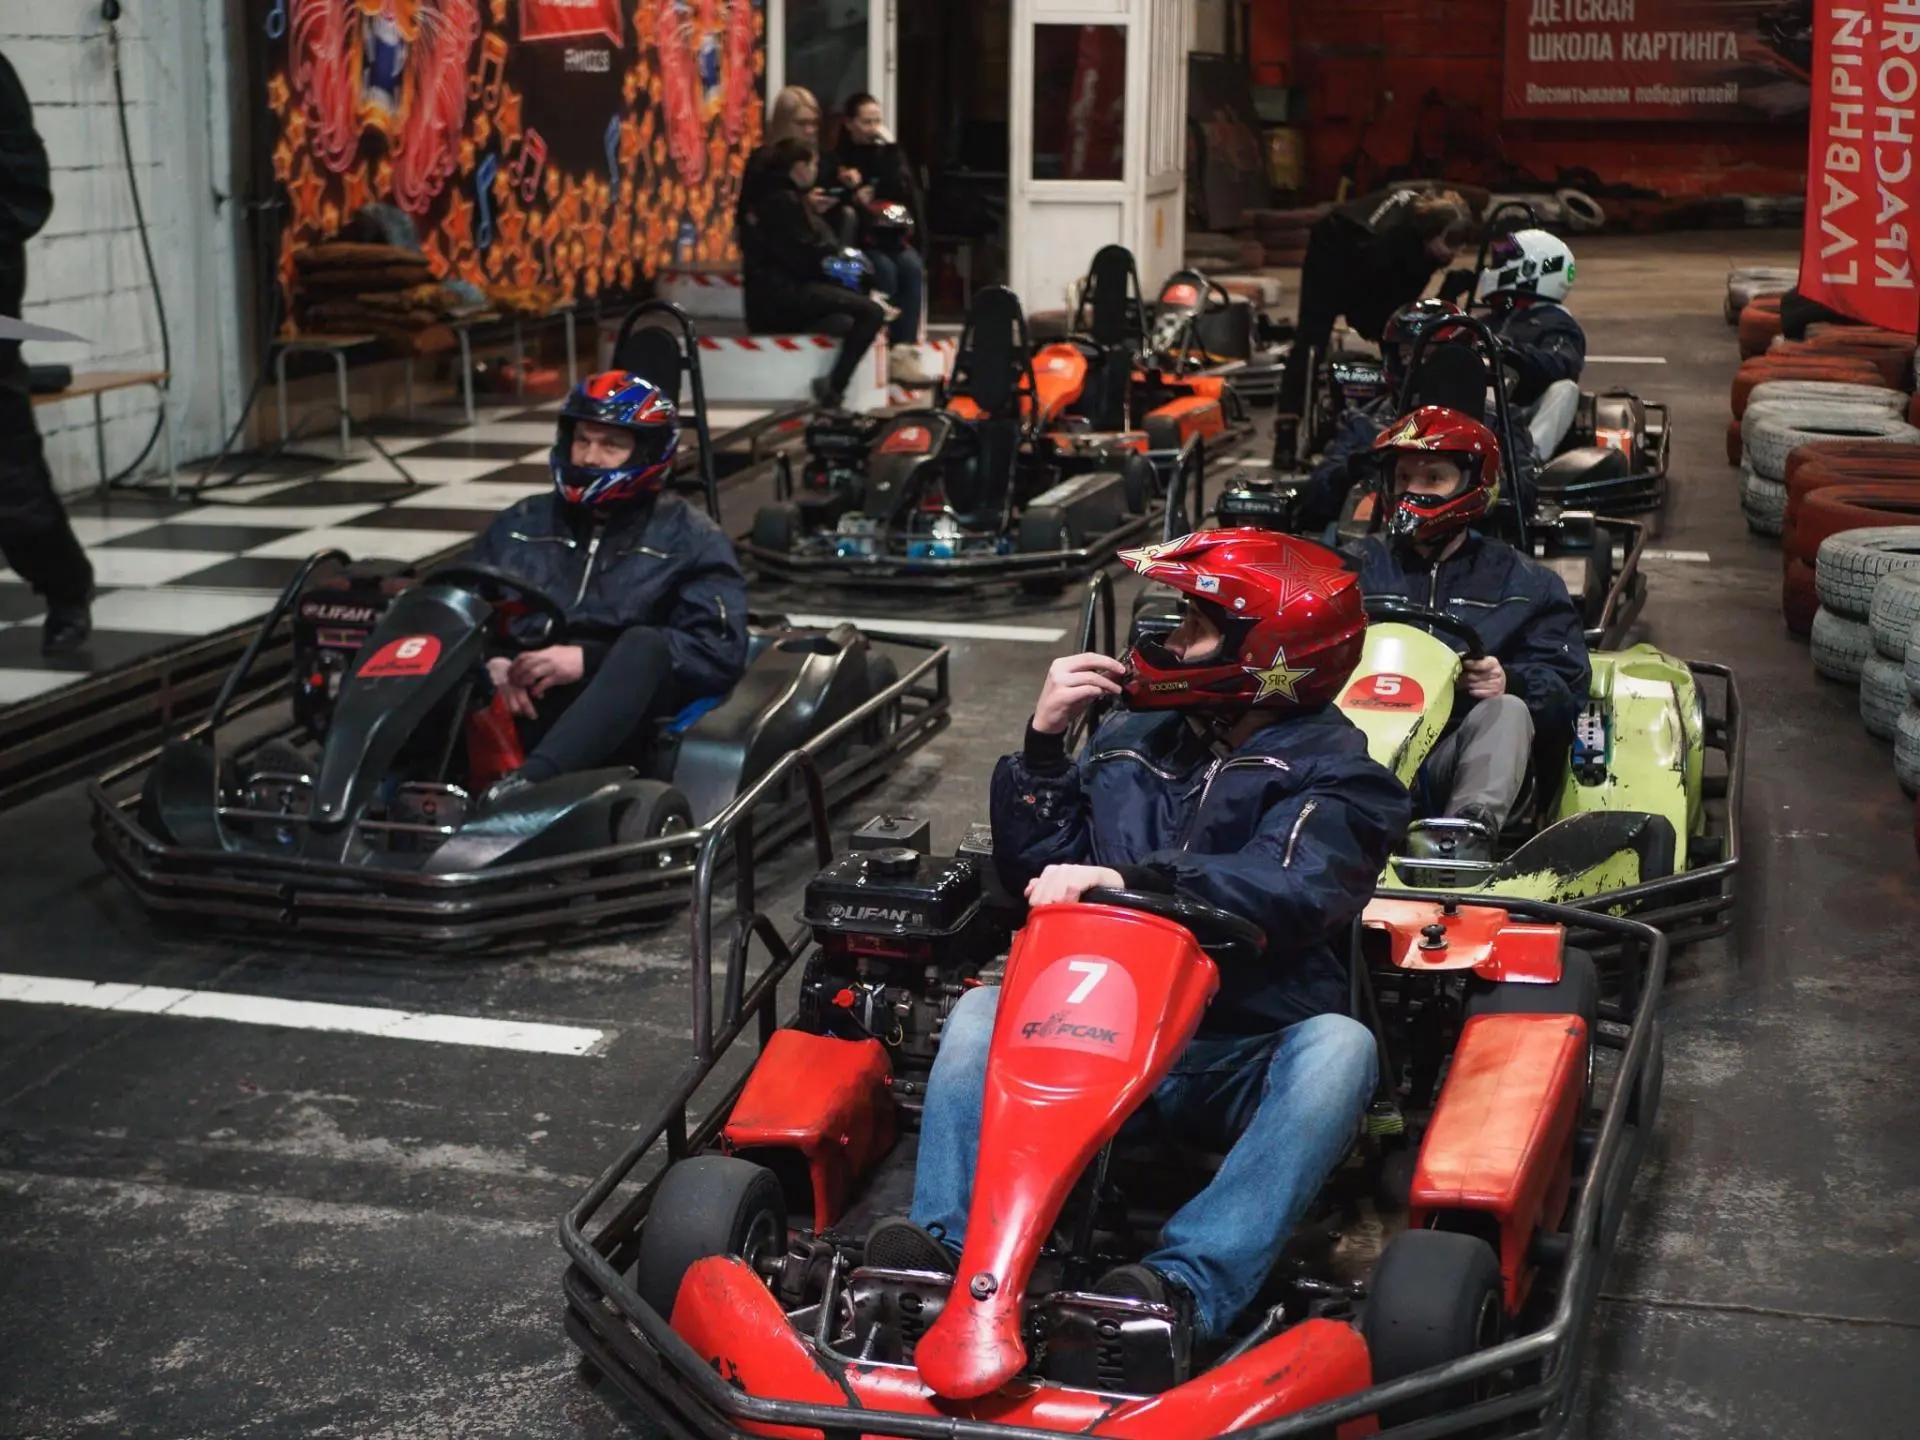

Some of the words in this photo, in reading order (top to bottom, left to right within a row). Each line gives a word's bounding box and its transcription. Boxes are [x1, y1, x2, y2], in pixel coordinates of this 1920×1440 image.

[1529, 0, 1635, 26] ДЕТСКАЯ
[1528, 33, 1614, 61] ШКОЛА
[1622, 31, 1739, 60] КАРТИНГА
[396, 637, 428, 659] 6
[1373, 675, 1402, 696] 5
[844, 905, 910, 923] LIFAN
[1066, 960, 1108, 1004] 7
